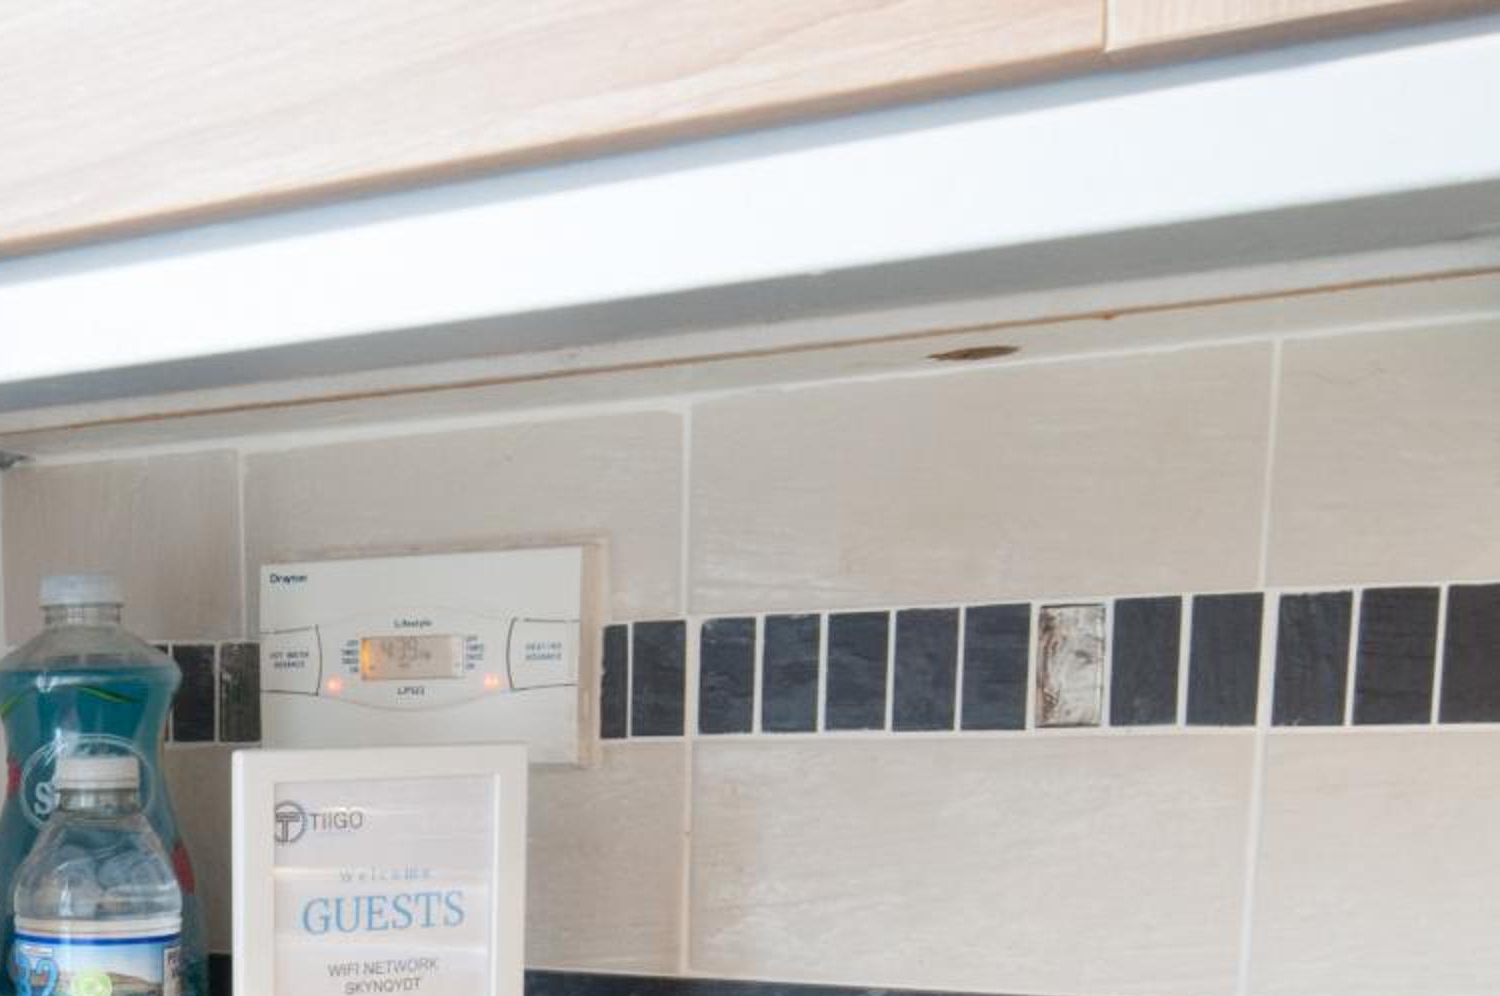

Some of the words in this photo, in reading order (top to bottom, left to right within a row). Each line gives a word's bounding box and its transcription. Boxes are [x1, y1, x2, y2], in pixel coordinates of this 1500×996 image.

[302, 890, 466, 935] GUESTS
[327, 962, 359, 978] WIFI
[363, 957, 438, 976] NETWORK
